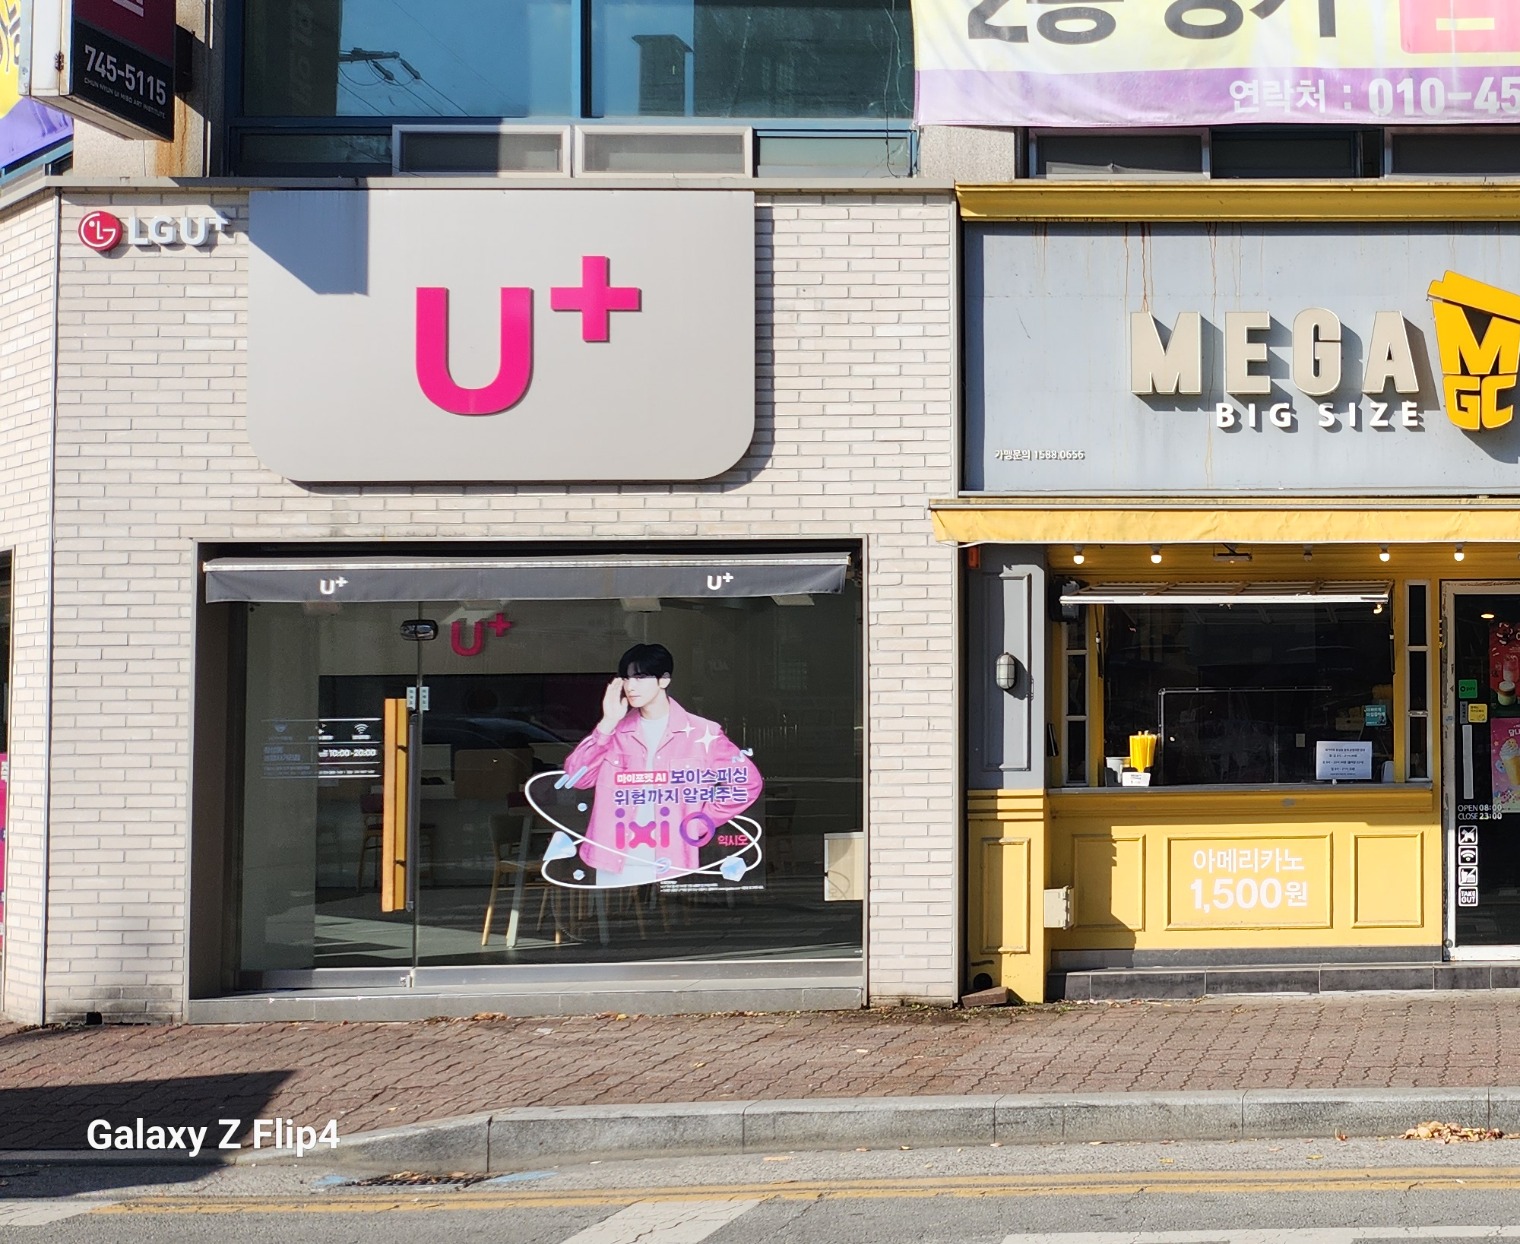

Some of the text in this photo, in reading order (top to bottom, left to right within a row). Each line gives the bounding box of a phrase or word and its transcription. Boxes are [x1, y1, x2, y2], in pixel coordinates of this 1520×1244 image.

[84, 44, 166, 106] 745-5115
[1229, 79, 1325, 113] 연락처
[416, 255, 641, 415] U+
[1130, 308, 1420, 396] MEGA
[1215, 402, 1291, 428] BIG
[1318, 401, 1420, 428] SIZE
[994, 449, 1031, 460] 가맹문의
[319, 575, 349, 596] U+
[706, 571, 735, 592] U+
[450, 612, 514, 658] U+
[655, 773, 667, 783] AI
[670, 767, 748, 785] 보이스피싱
[614, 786, 748, 805] 위험까지 알려주는
[1457, 804, 1503, 812] OPEN 08:00
[1457, 812, 1503, 820] CLOSE 23:00
[1192, 847, 1305, 874] 아메리카노
[1190, 879, 1309, 914] 1,500원
